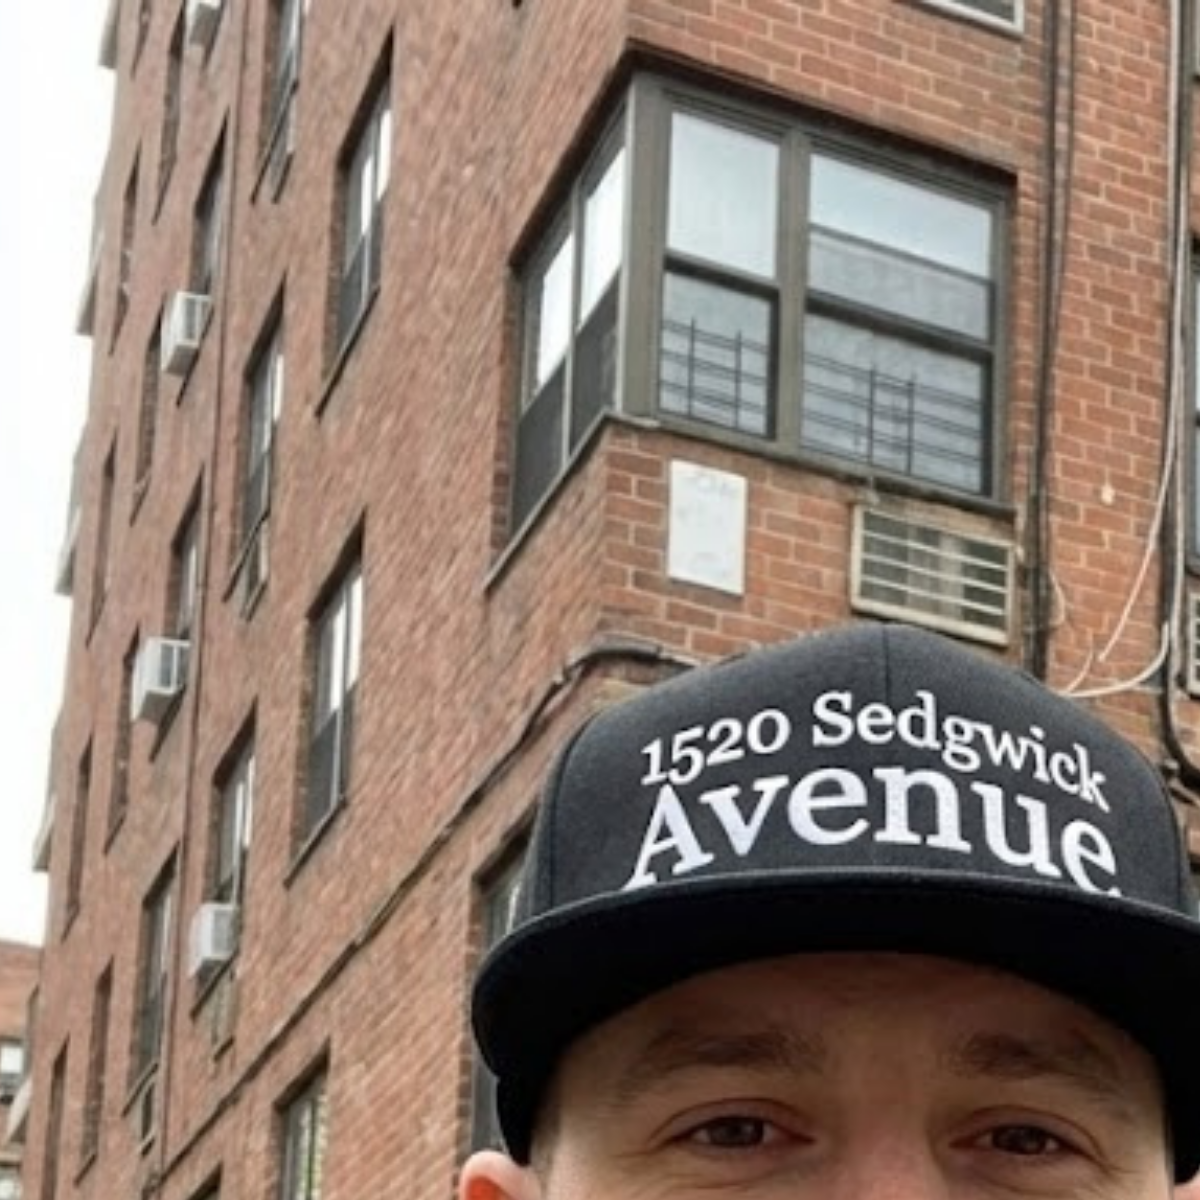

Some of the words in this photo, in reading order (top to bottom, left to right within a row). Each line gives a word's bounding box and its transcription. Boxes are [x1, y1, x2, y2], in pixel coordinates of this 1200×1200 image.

[640, 707, 791, 786] 1520
[812, 689, 1112, 813] Sedgwick
[621, 766, 1122, 898] Avenue
